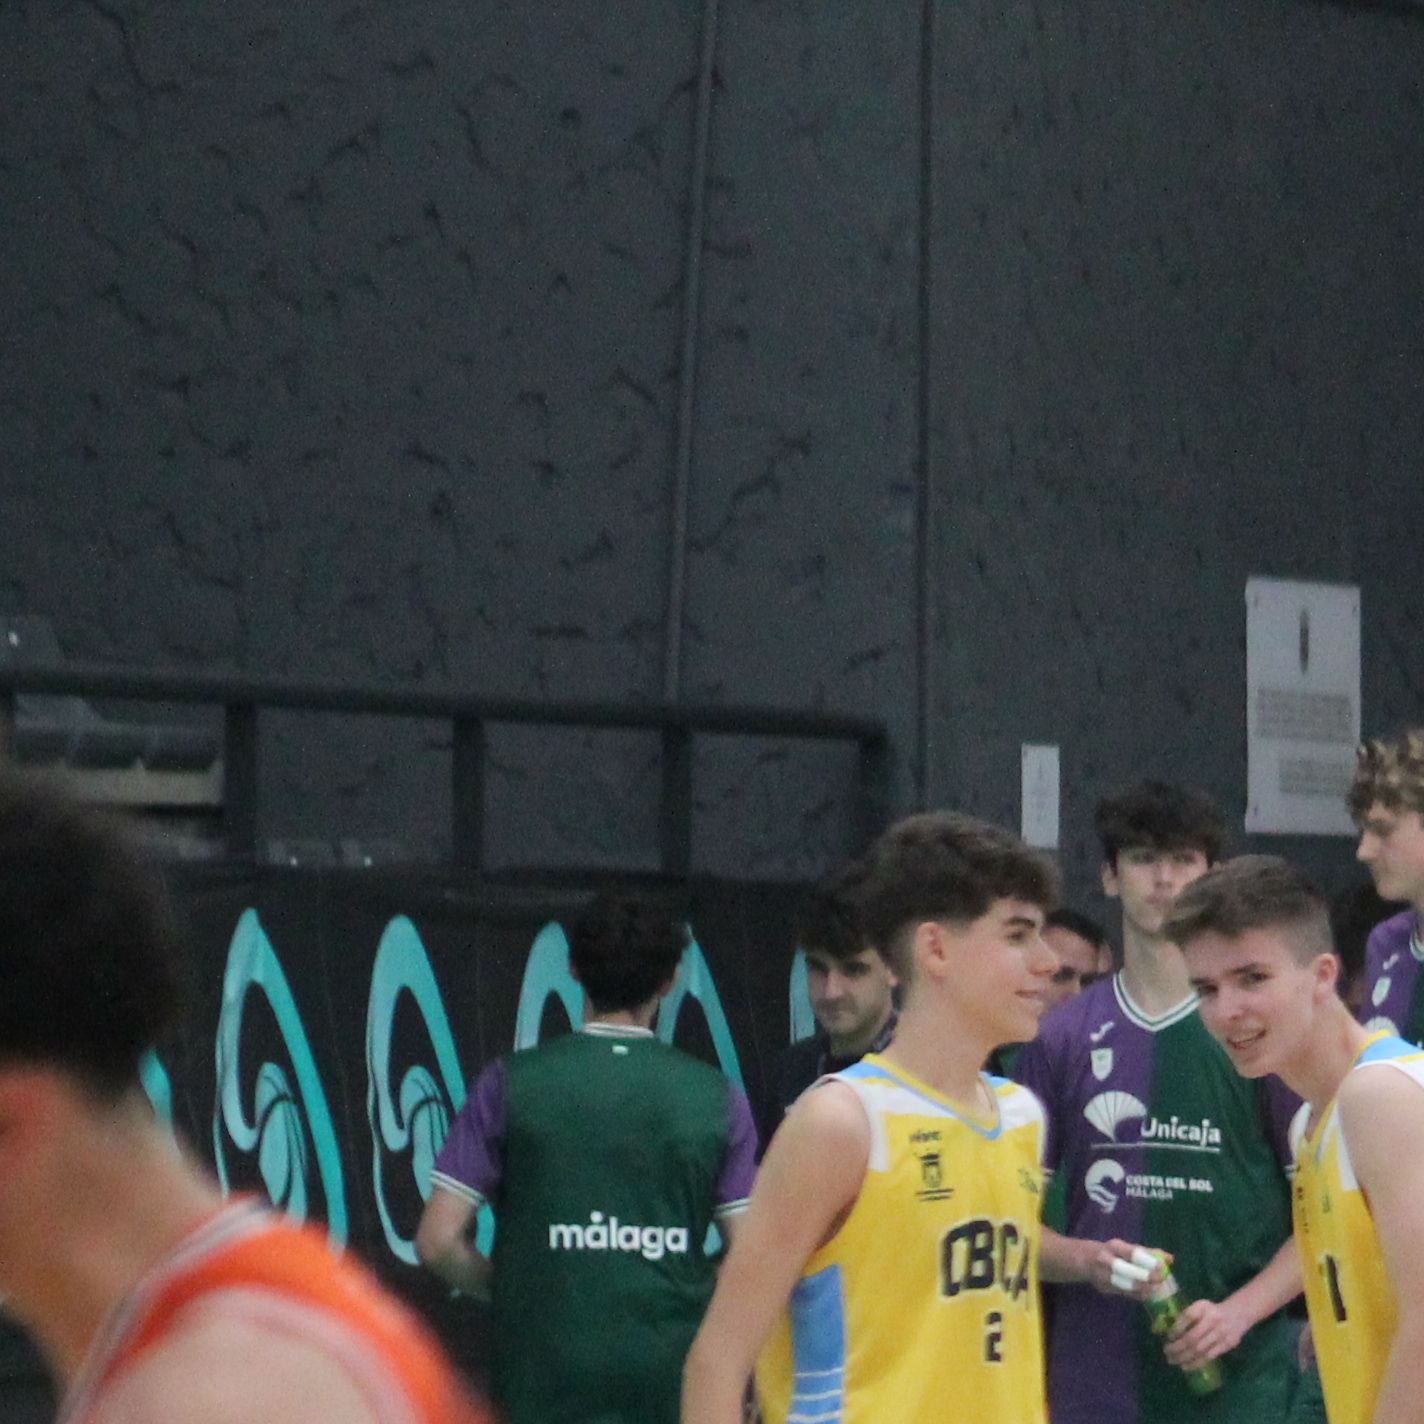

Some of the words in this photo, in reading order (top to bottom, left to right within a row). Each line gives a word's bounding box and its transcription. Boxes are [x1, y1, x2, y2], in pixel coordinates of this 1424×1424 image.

[1140, 1115, 1221, 1146] Unicaja
[1125, 1174, 1165, 1188] COSTA
[1165, 1177, 1187, 1190] DEL
[1189, 1178, 1214, 1193] SOL
[984, 1310, 1003, 1362] 2
